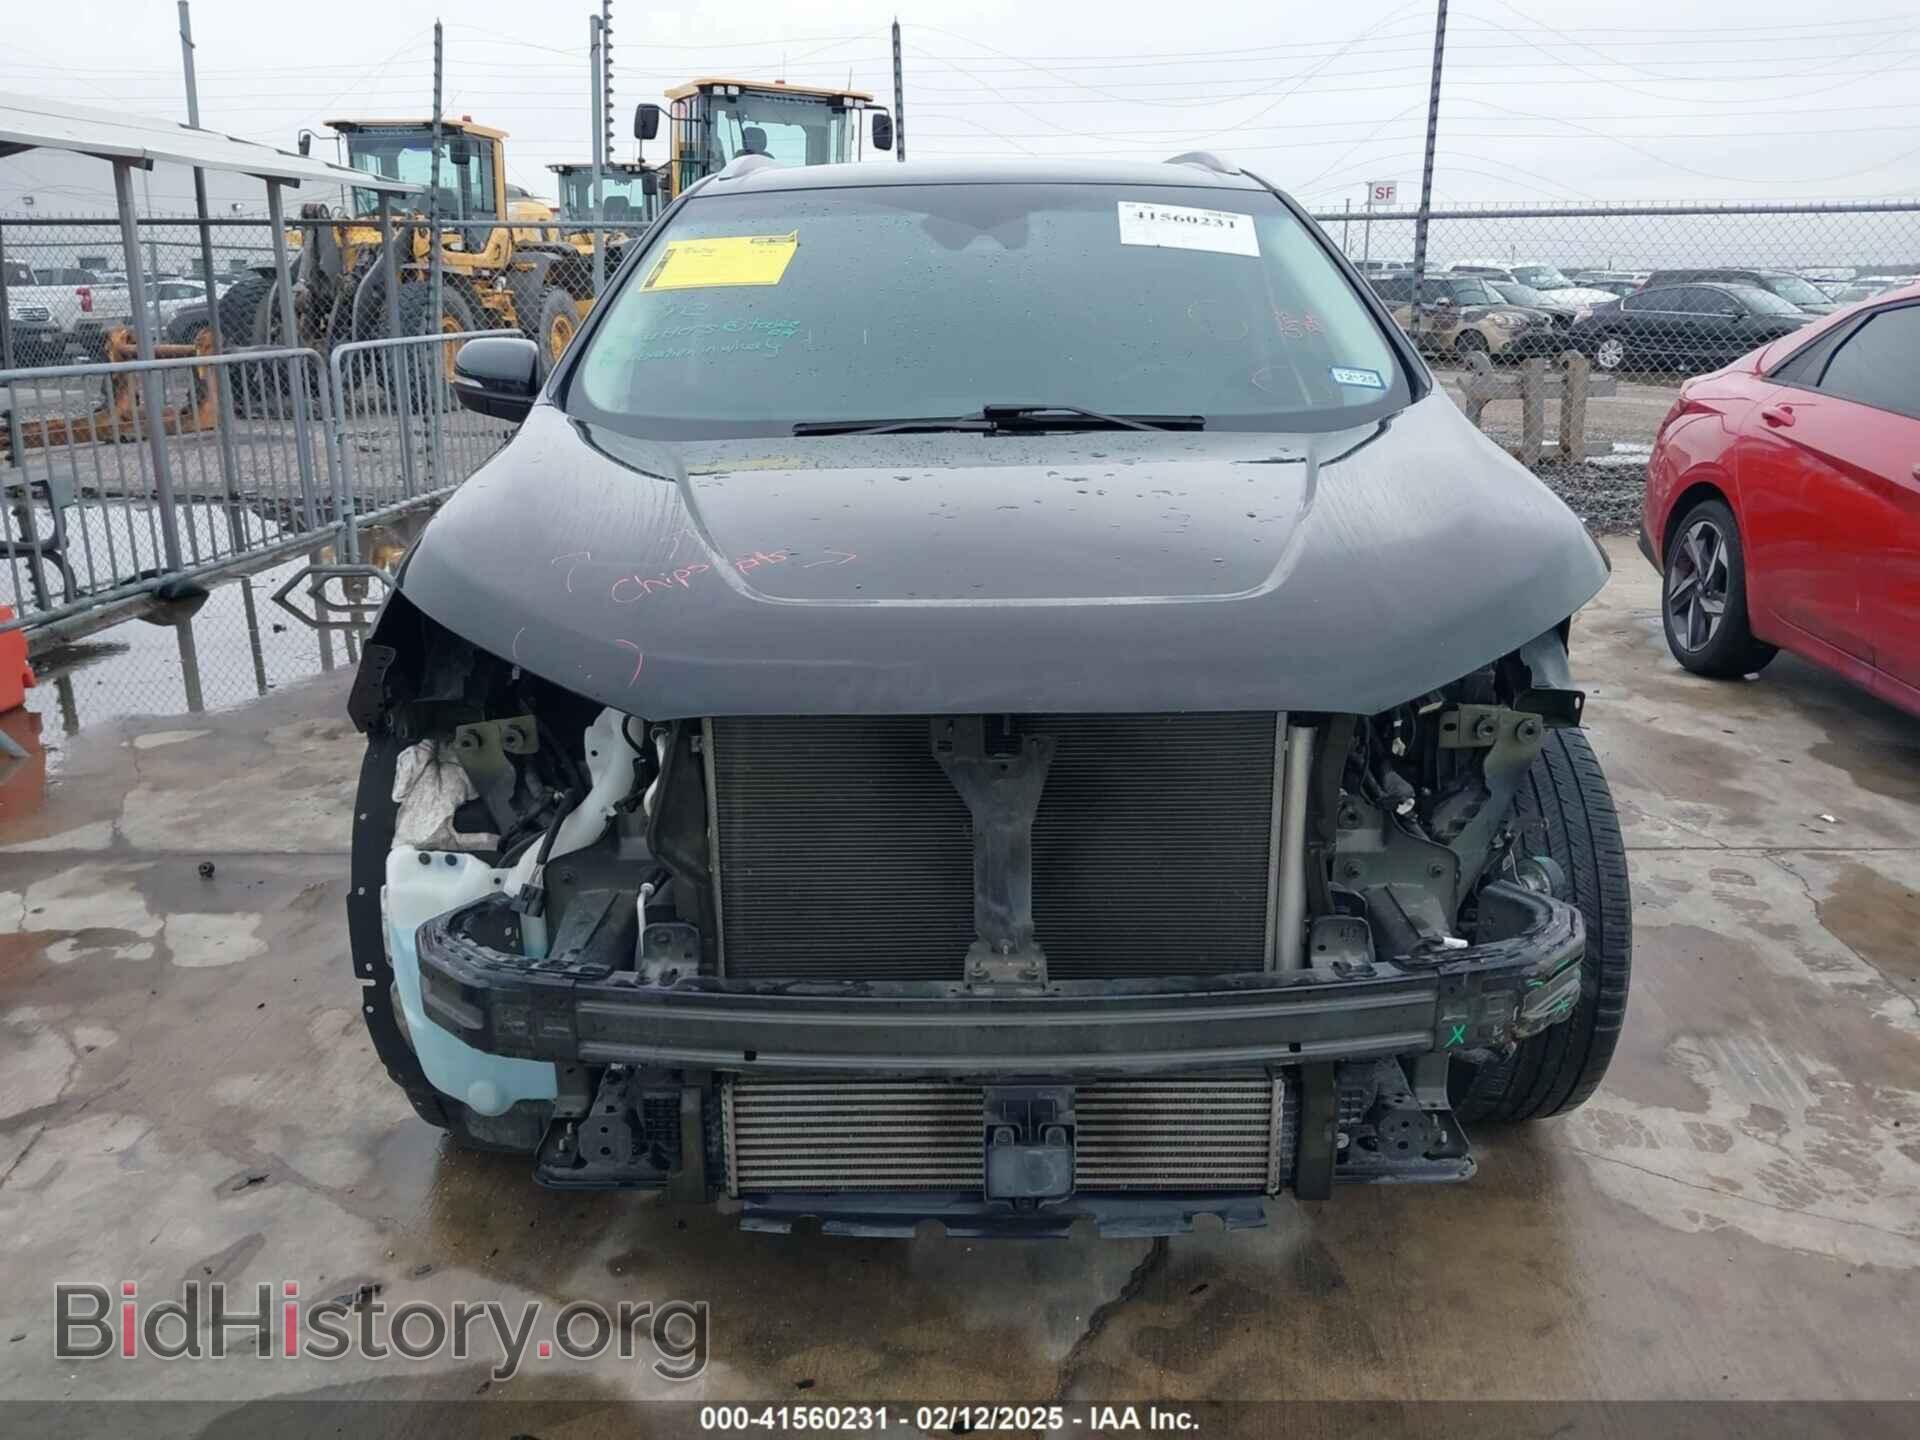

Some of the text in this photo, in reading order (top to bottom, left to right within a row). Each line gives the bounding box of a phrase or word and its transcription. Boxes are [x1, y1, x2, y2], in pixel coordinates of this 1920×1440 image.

[1375, 186, 1394, 200] SF
[1133, 210, 1236, 230] 41560231
[611, 565, 709, 602] Chips
